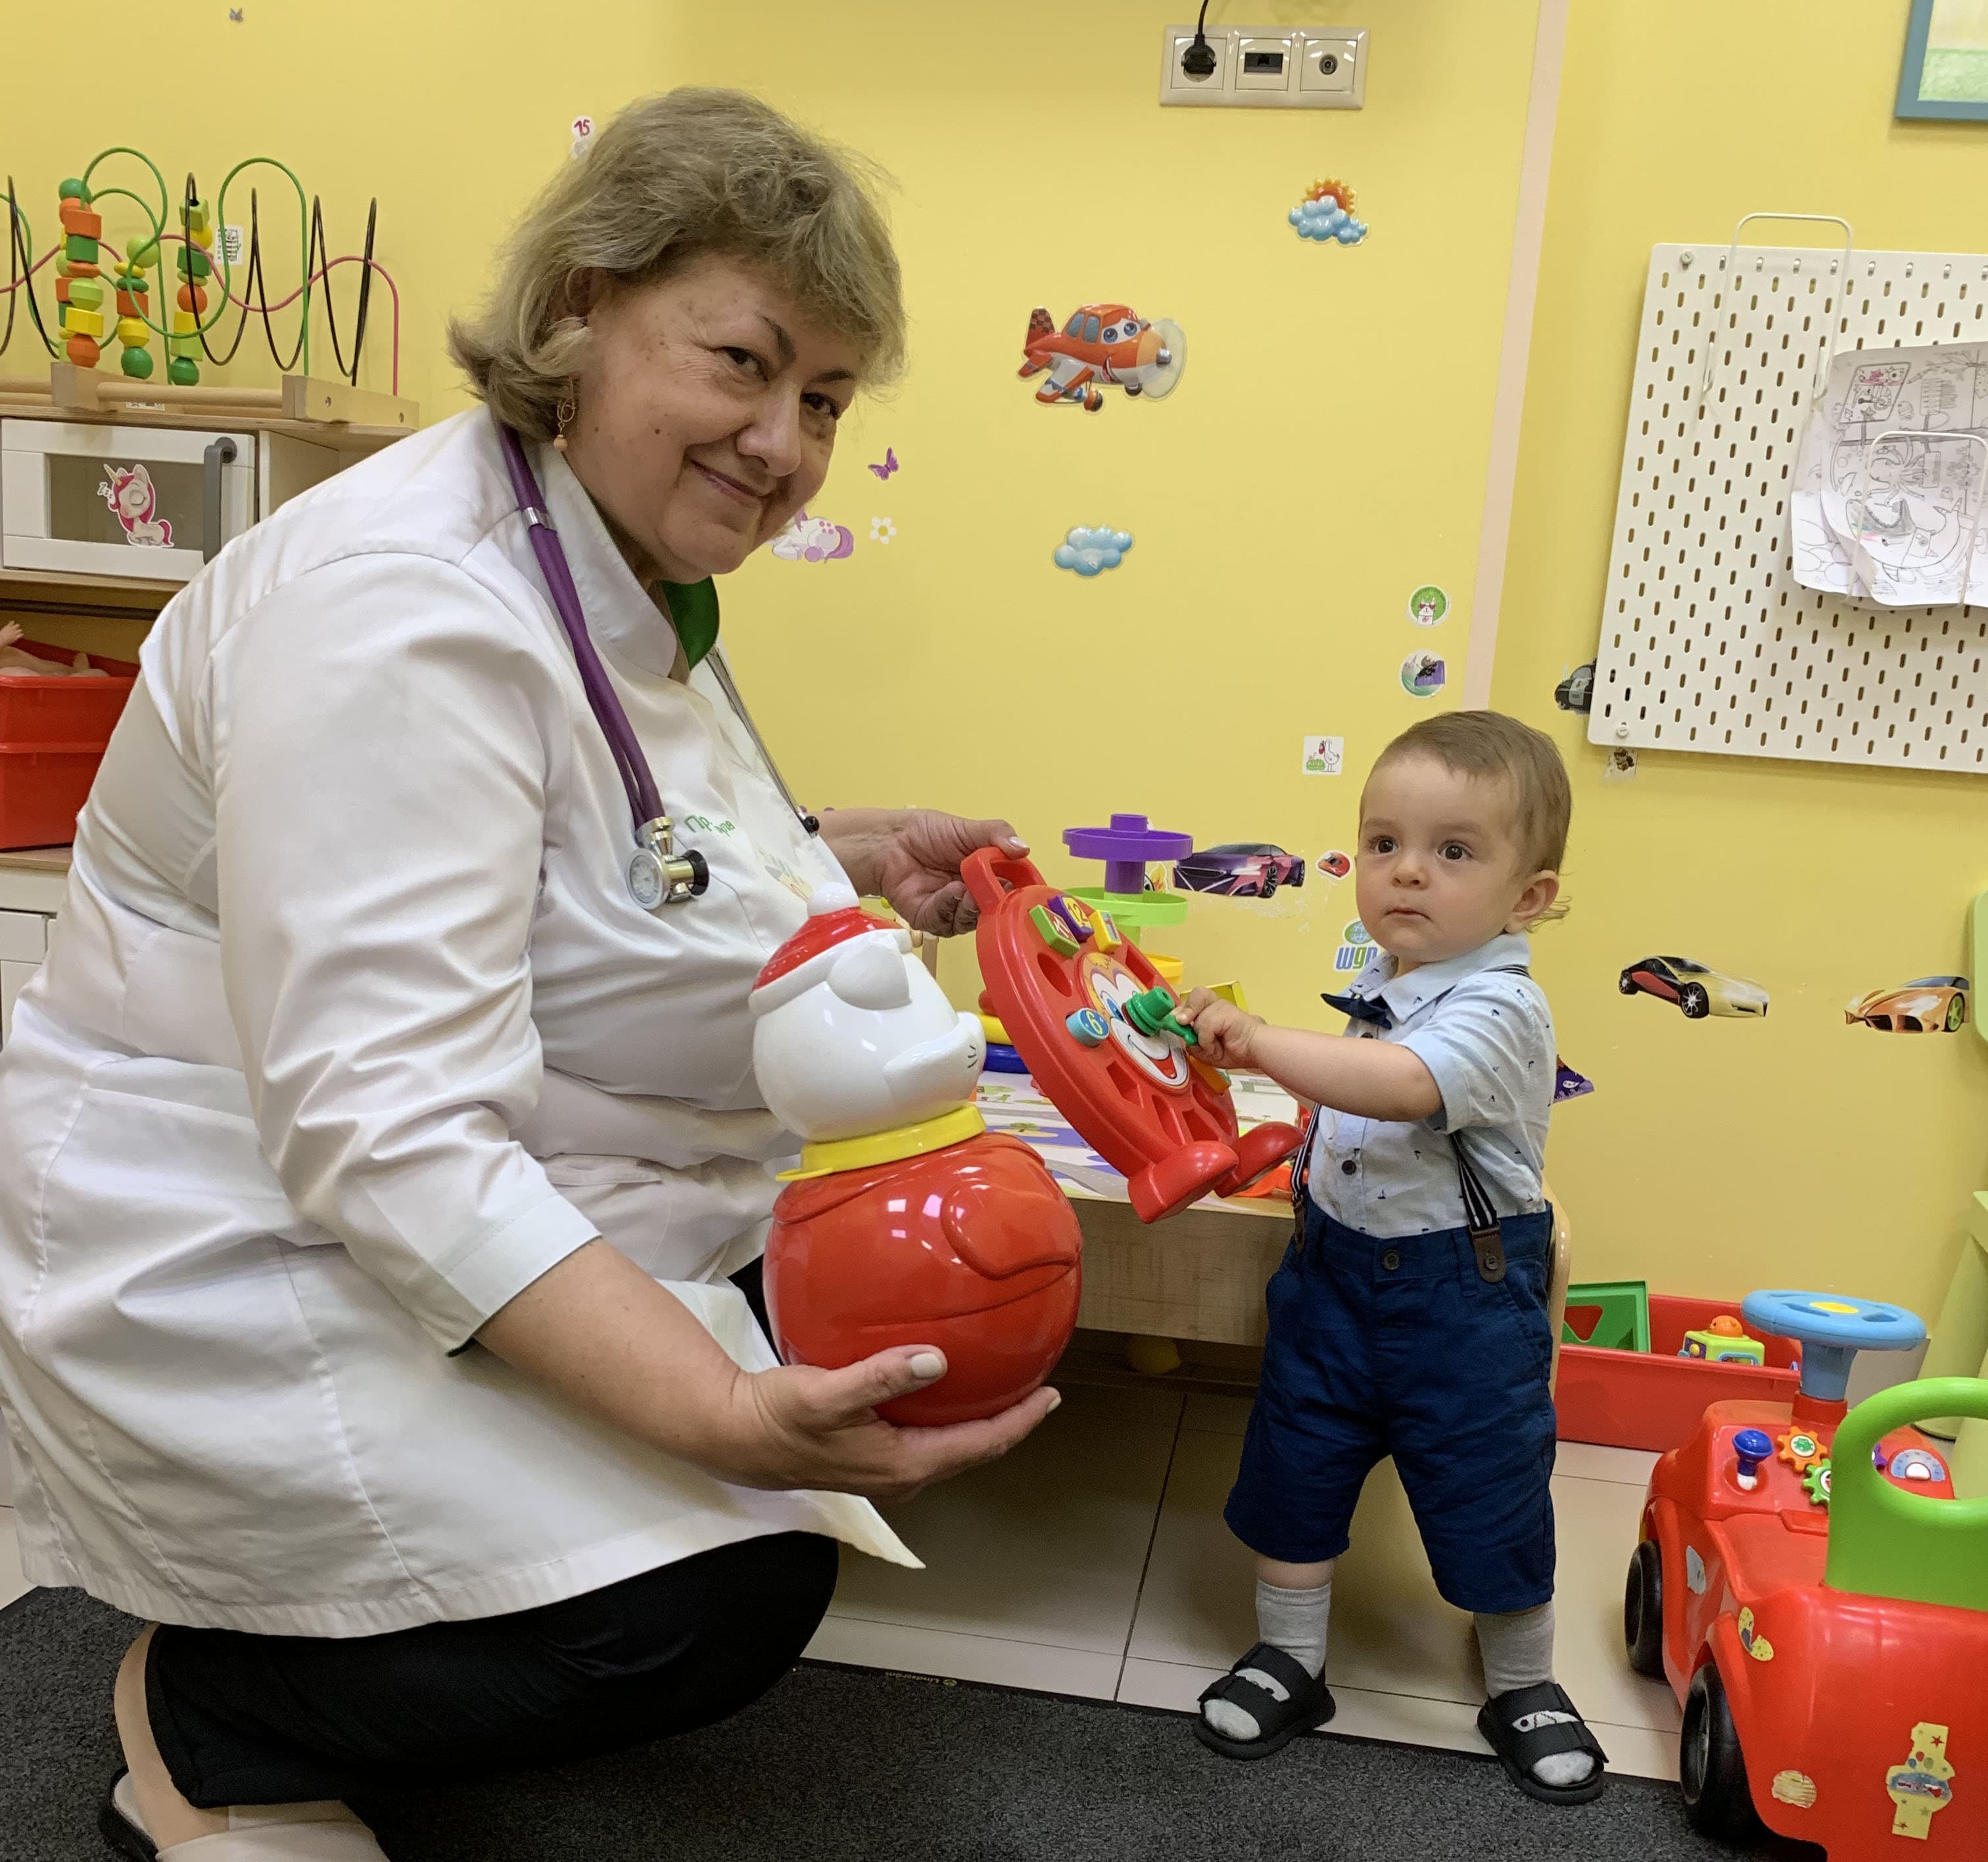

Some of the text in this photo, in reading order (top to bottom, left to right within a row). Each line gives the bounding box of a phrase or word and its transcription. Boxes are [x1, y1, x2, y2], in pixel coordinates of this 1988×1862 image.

[573, 119, 590, 137] 15
[1068, 903, 1089, 925] 12
[1053, 915, 1070, 939] 11
[1104, 919, 1118, 940] 1
[1085, 1010, 1103, 1036] 6
